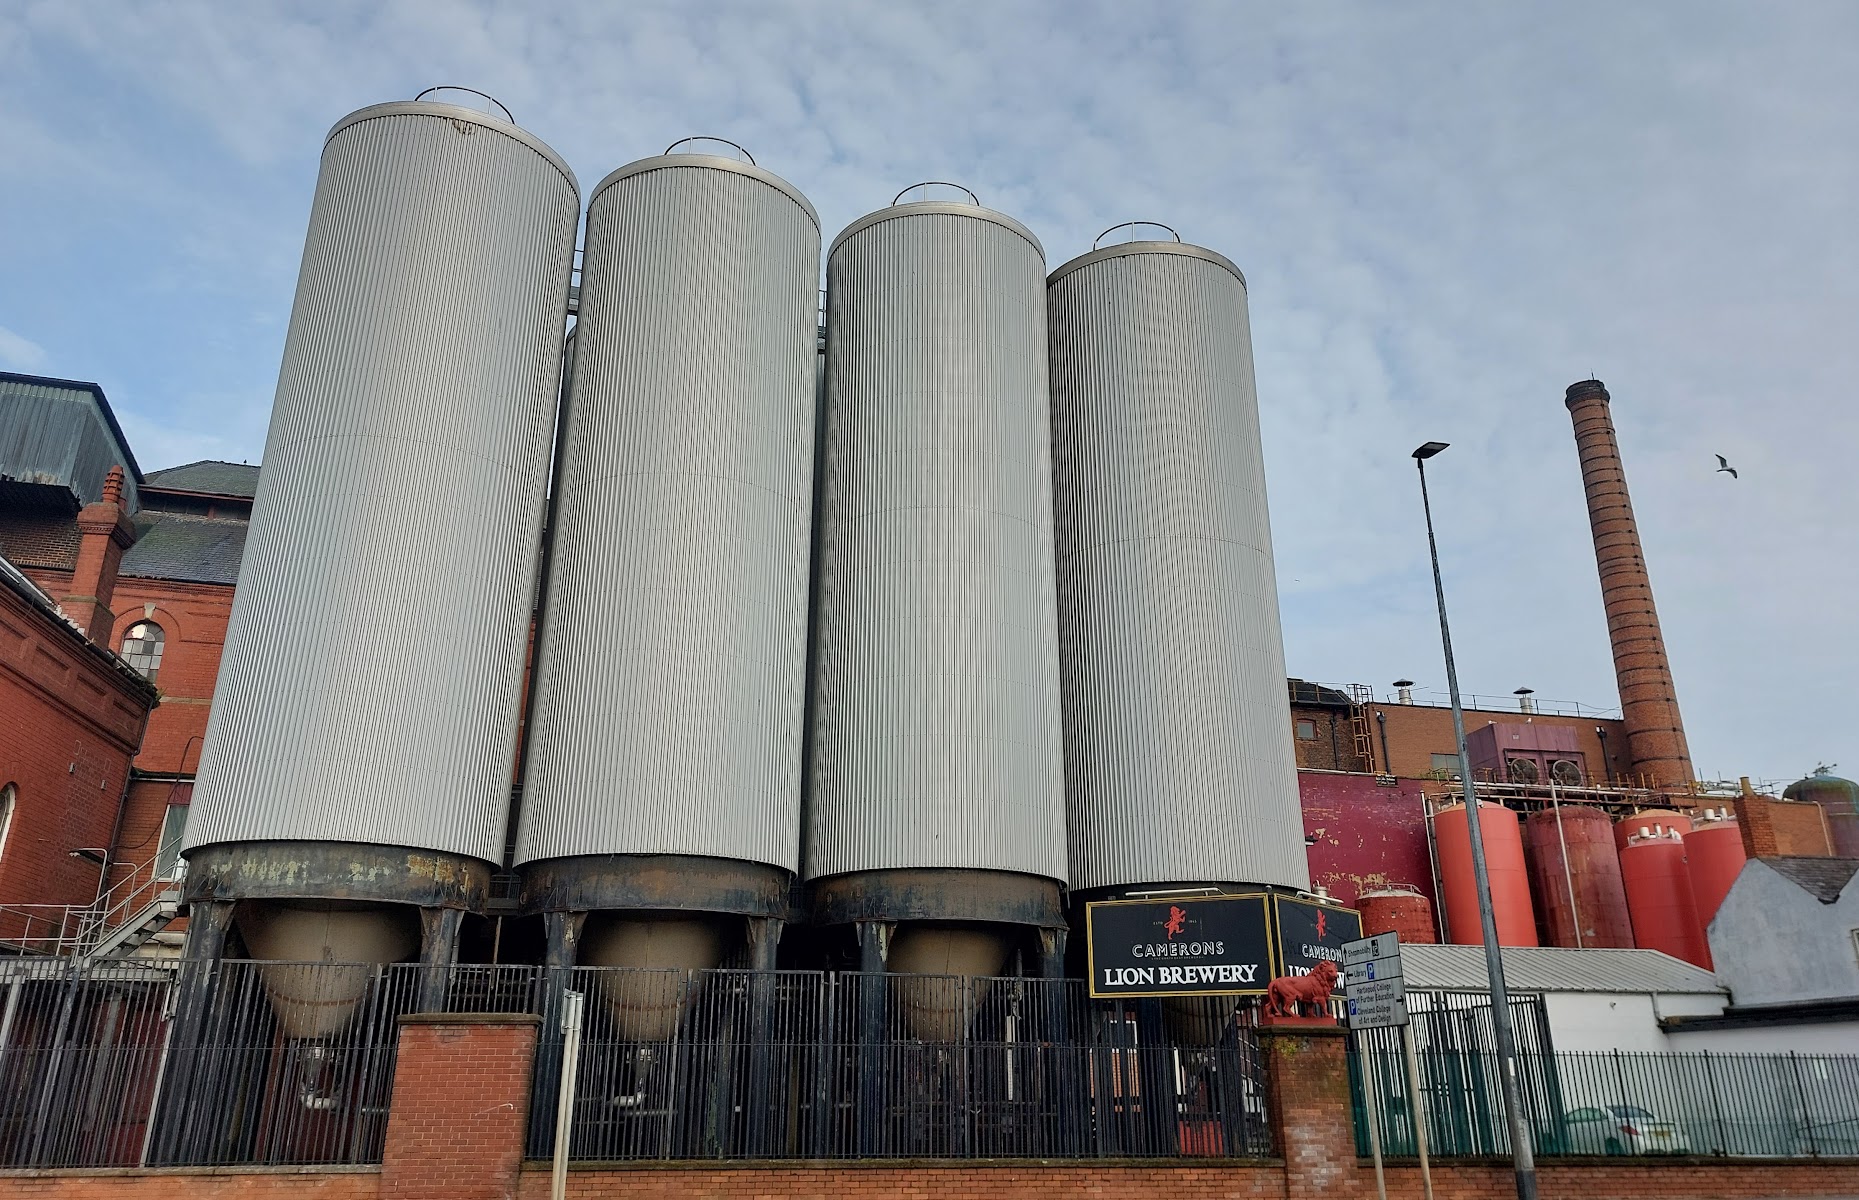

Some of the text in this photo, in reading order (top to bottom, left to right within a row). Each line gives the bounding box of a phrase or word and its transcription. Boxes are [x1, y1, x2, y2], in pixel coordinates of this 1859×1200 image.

[1131, 941, 1225, 958] CAMERONS
[1301, 943, 1343, 963] CAMERON
[1104, 964, 1258, 987] LION BREWERY
[1354, 970, 1367, 978] Library
[1357, 983, 1391, 994] Hartlepool College
[1356, 993, 1394, 1004] of Further Education
[1357, 1005, 1391, 1015] Cleveland College
[1370, 1015, 1378, 1023] and
[1378, 1015, 1391, 1025] Design
